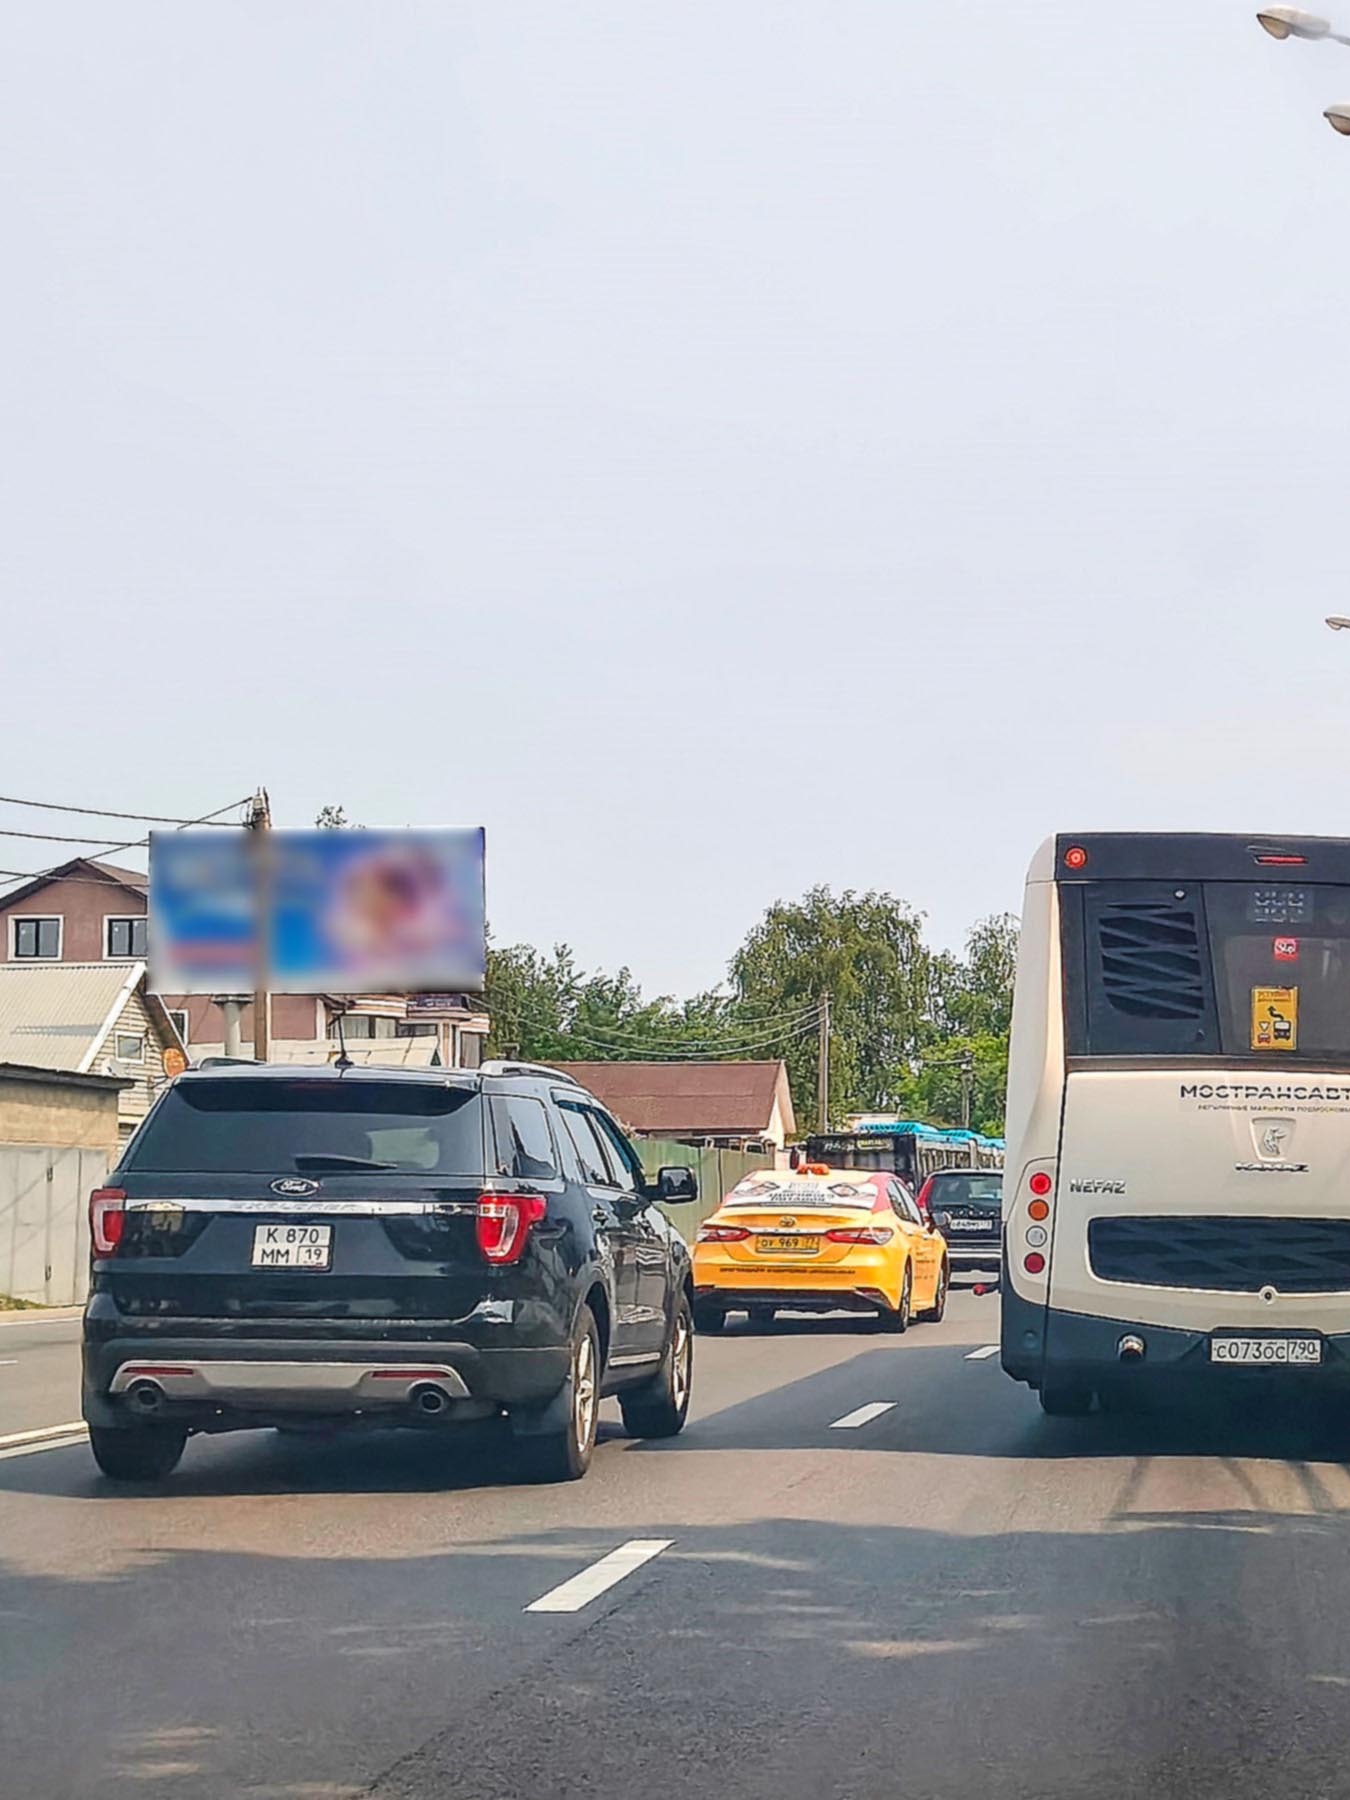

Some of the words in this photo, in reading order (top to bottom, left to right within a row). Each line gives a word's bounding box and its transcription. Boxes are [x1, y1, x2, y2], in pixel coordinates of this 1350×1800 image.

[286, 1227, 320, 1244] 870
[305, 1248, 322, 1261] 19
[1288, 1341, 1316, 1355] 790
